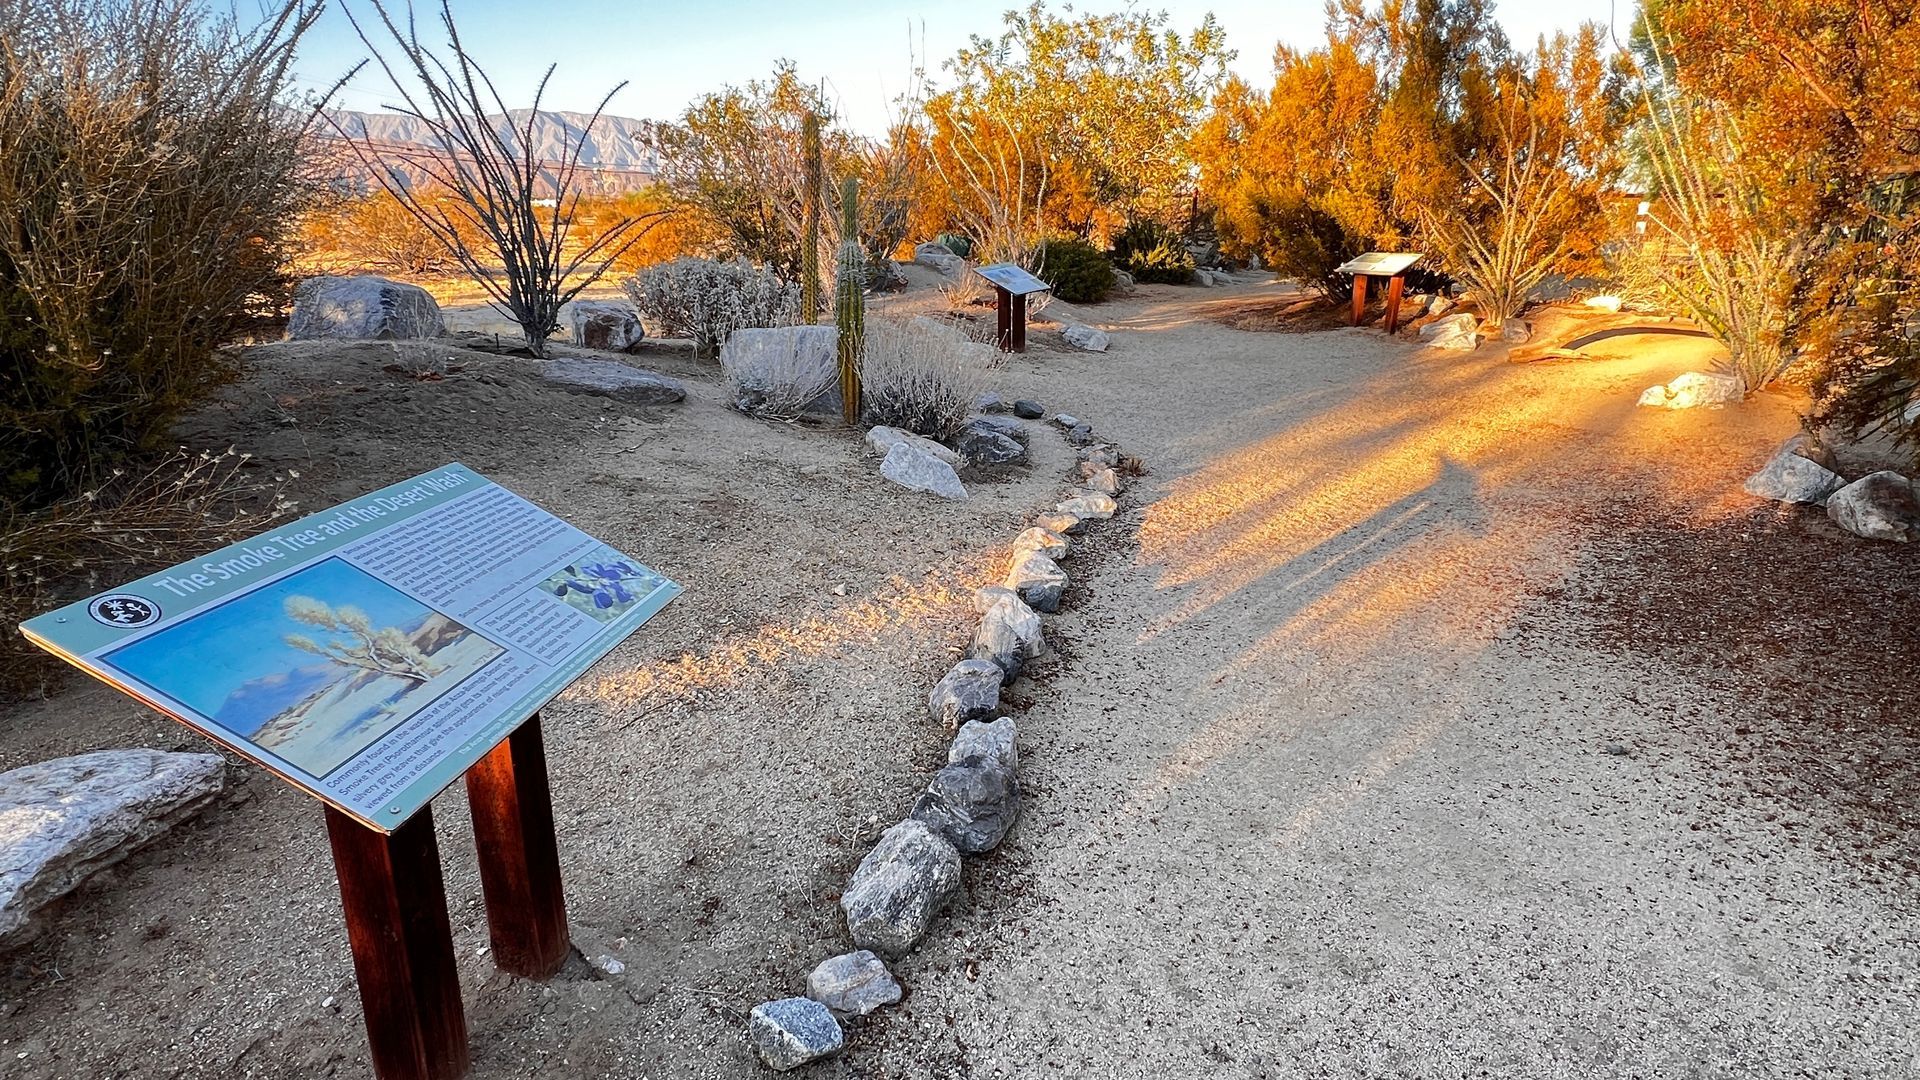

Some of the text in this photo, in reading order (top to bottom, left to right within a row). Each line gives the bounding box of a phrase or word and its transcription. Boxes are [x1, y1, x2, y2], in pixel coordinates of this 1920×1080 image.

[153, 574, 215, 596] The
[202, 546, 284, 579] Smoke
[269, 530, 326, 551] Tree
[318, 513, 359, 535] and
[347, 505, 387, 522] the
[374, 485, 434, 511] Desert
[419, 471, 469, 492] Wash
[326, 760, 370, 788] Commonly
[366, 743, 390, 760] found
[395, 730, 410, 740] the
[365, 788, 393, 809] viewed
[390, 775, 410, 789] from
[415, 750, 446, 771] distance.
